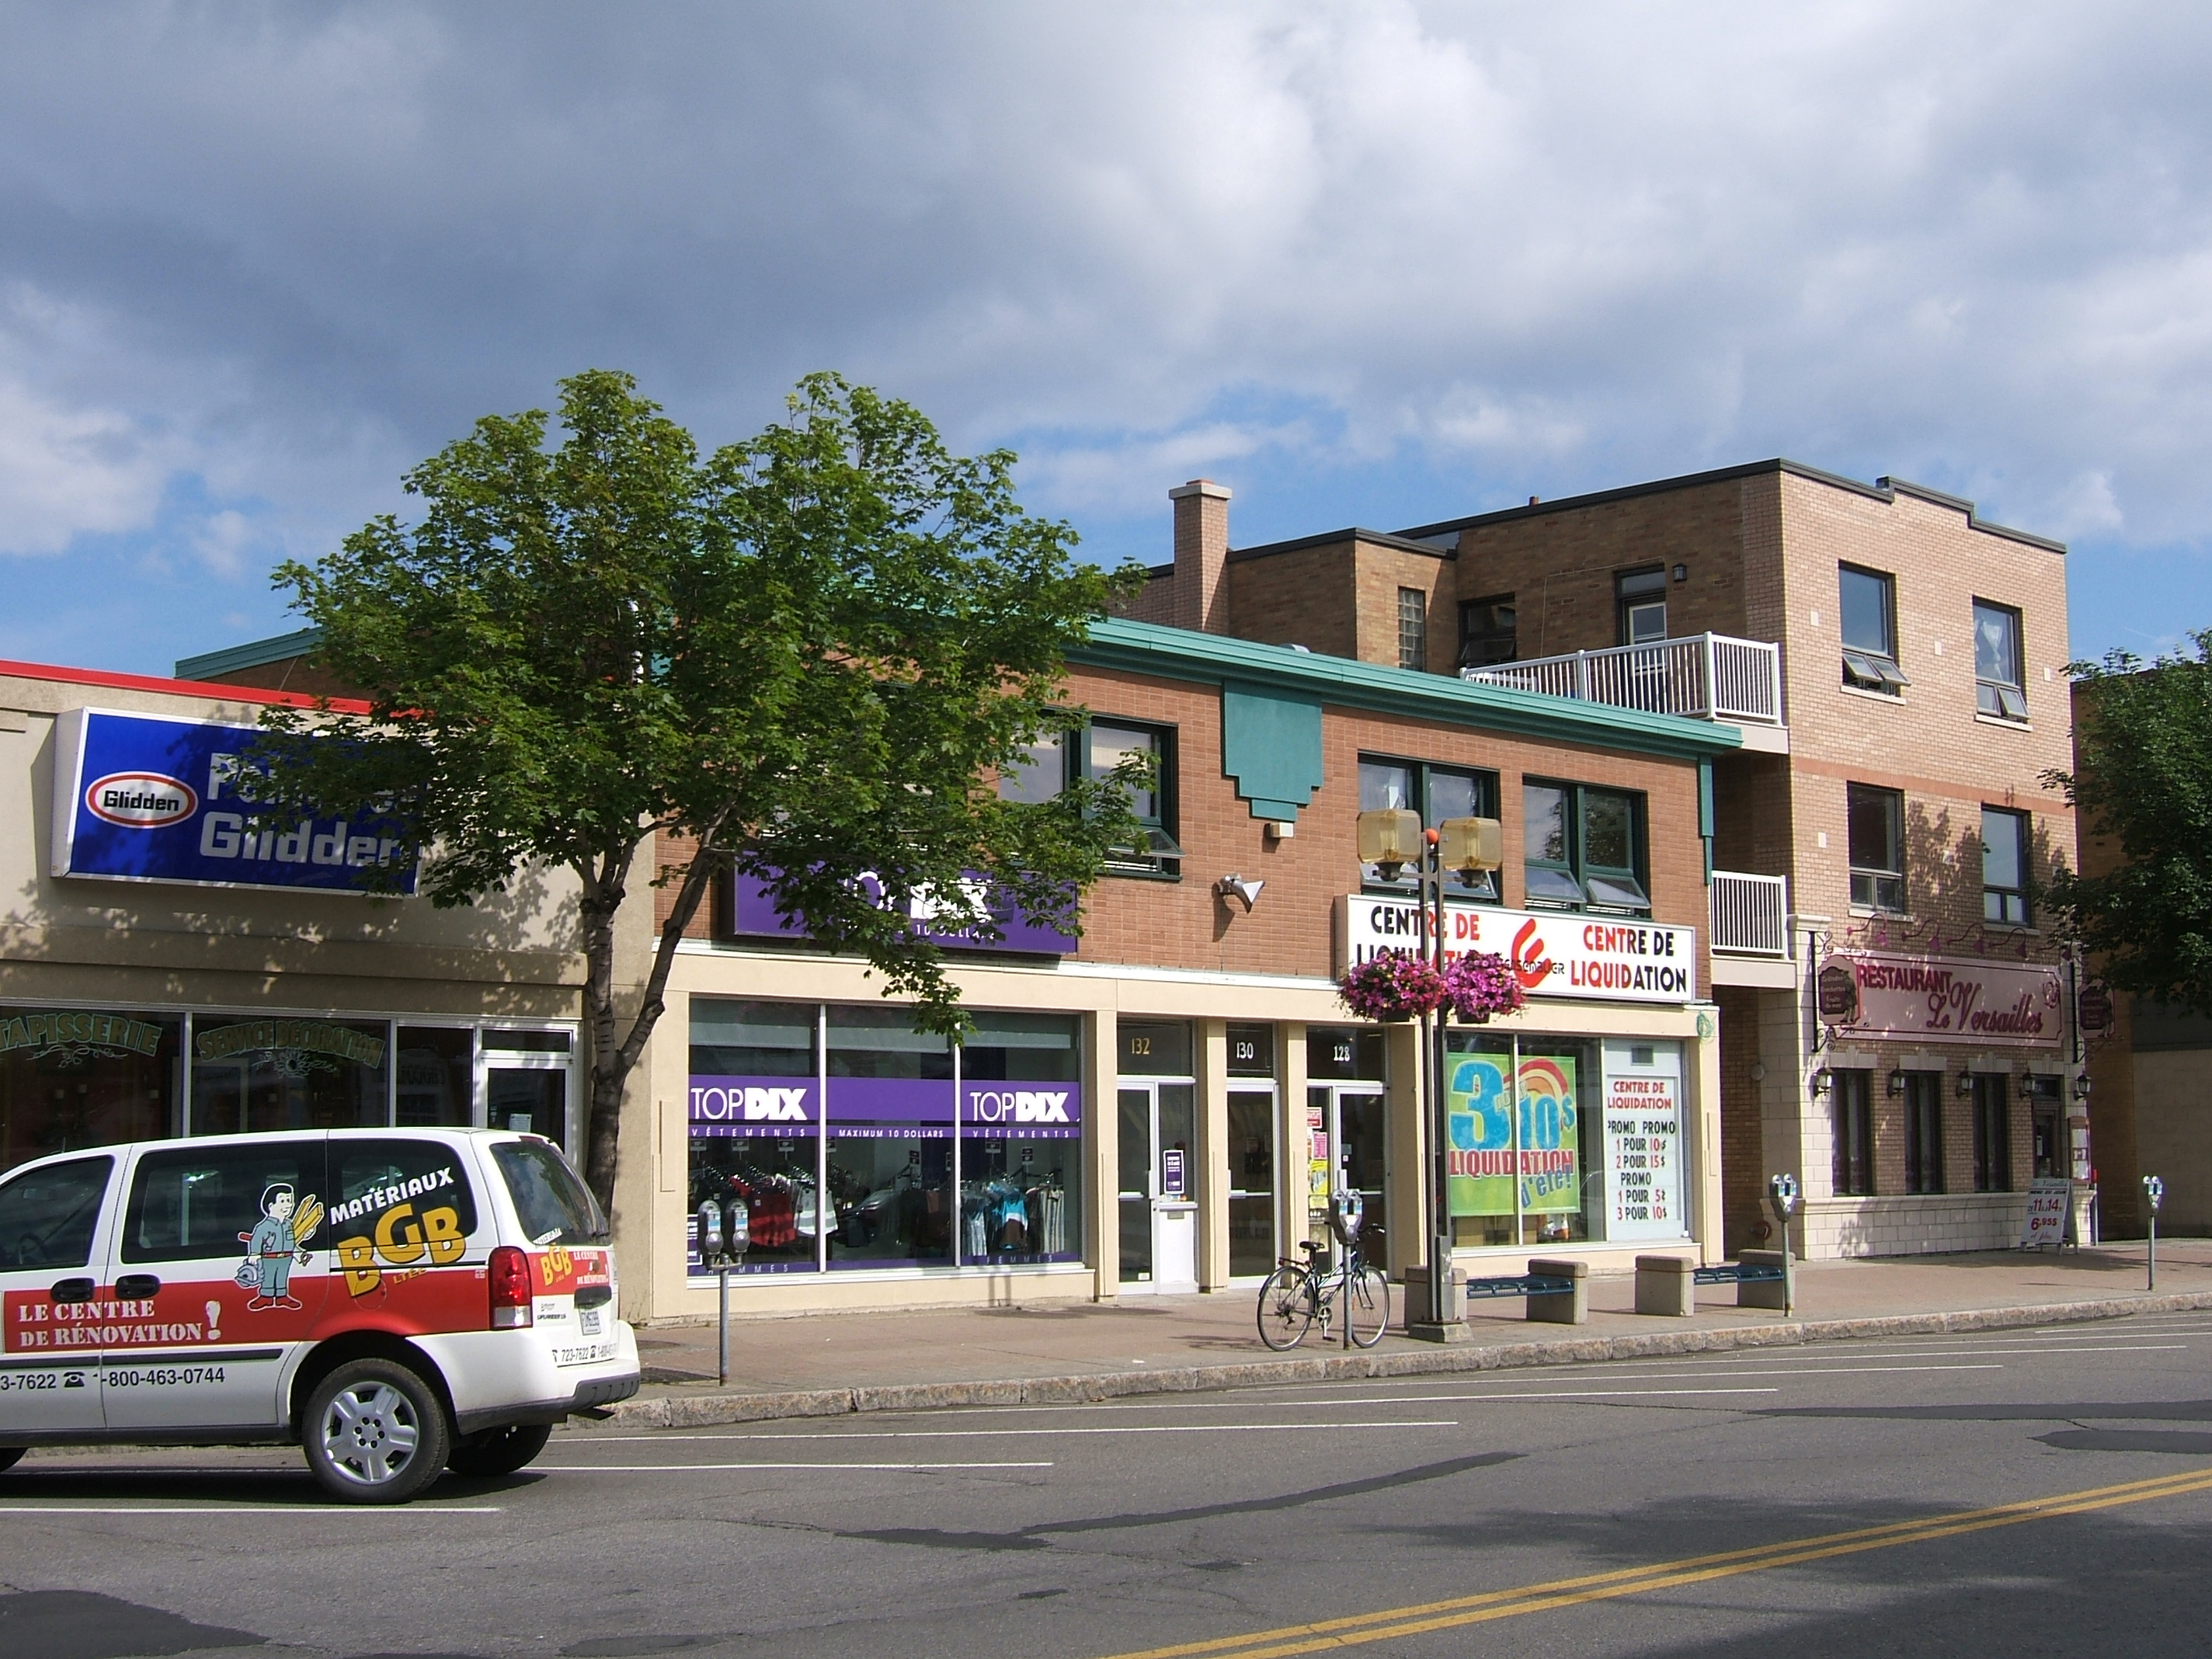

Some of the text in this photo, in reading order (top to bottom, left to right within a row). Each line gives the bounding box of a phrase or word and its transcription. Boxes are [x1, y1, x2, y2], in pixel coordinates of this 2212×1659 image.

[103, 789, 179, 812] Glidden
[1456, 913, 1480, 941] DE
[1583, 924, 1675, 957] CENTRE DE
[1570, 960, 1687, 993] LIQUIDATION
[1856, 965, 1953, 994] RESTAURANT
[1926, 993, 1950, 1028] Le
[1949, 981, 2044, 1034] Versailles
[197, 1021, 274, 1062] SERVICE
[1131, 1038, 1150, 1055] 132
[1236, 1042, 1254, 1059] 130
[1334, 1045, 1351, 1062] 128
[1613, 1080, 1665, 1094] CENTRE DE
[1450, 1059, 1511, 1150] 3
[1608, 1097, 1672, 1110] LIQUIDATION
[839, 1129, 944, 1139] MAXIMUM 10 DOLLARS
[1643, 1121, 1676, 1135] PROMO
[1616, 1139, 1620, 1151] 1
[1623, 1138, 1647, 1151] POUR
[1449, 1150, 1574, 1179] LIQUIDATION
[1616, 1155, 1621, 1169] 2
[1623, 1155, 1647, 1169] POUR
[1620, 1172, 1652, 1186] PROMO
[329, 1167, 455, 1226] MATÉRIAUX
[1618, 1190, 1622, 1203] 1
[1626, 1190, 1649, 1202] POUR
[1617, 1207, 1623, 1220] 3
[1626, 1207, 1648, 1220] POUR
[337, 1202, 466, 1299] BGB
[986, 1254, 1053, 1264] FEMMES
[540, 1242, 572, 1287] BGB
[19, 1299, 155, 1322] LE CENTRE
[20, 1330, 48, 1347] DE
[92, 1367, 226, 1387] -800-463-0744
